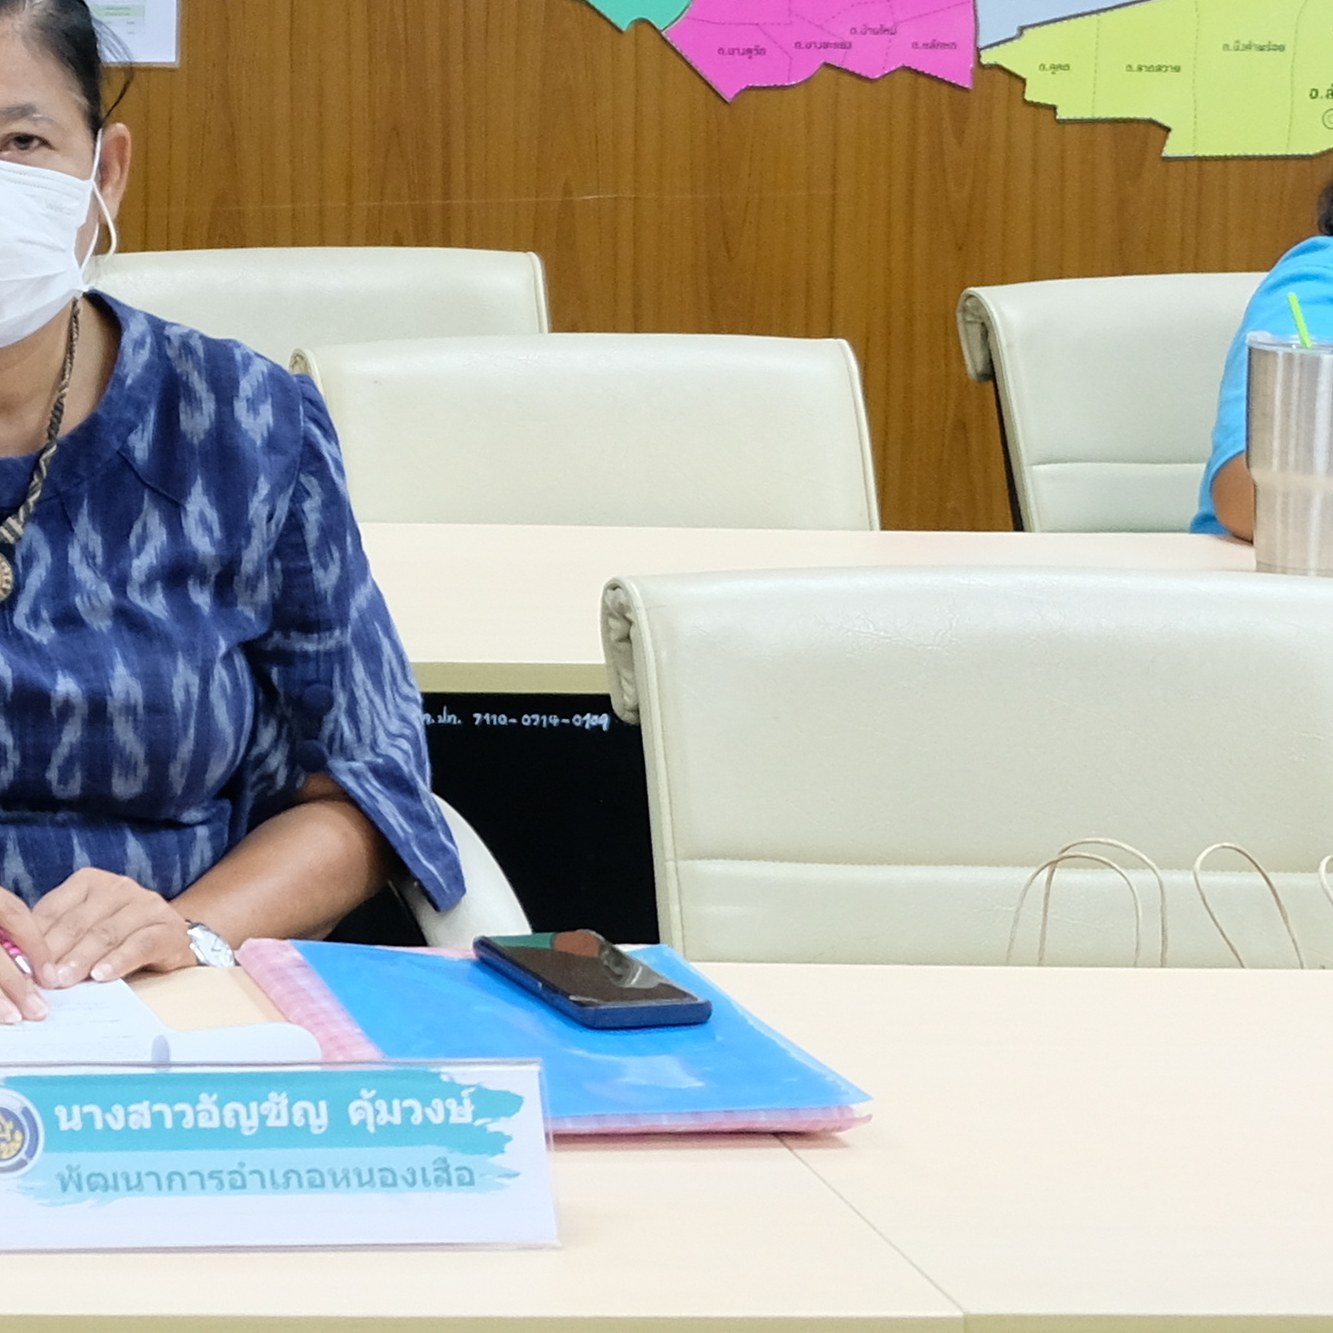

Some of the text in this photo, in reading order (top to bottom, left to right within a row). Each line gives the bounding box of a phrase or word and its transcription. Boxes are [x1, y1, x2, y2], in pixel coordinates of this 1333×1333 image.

[54, 1084, 476, 1136] นางสาวอัญชัญ คุ้มวงษ์
[56, 1154, 477, 1196] พัฒนาการอำเภอหนองเสือ
